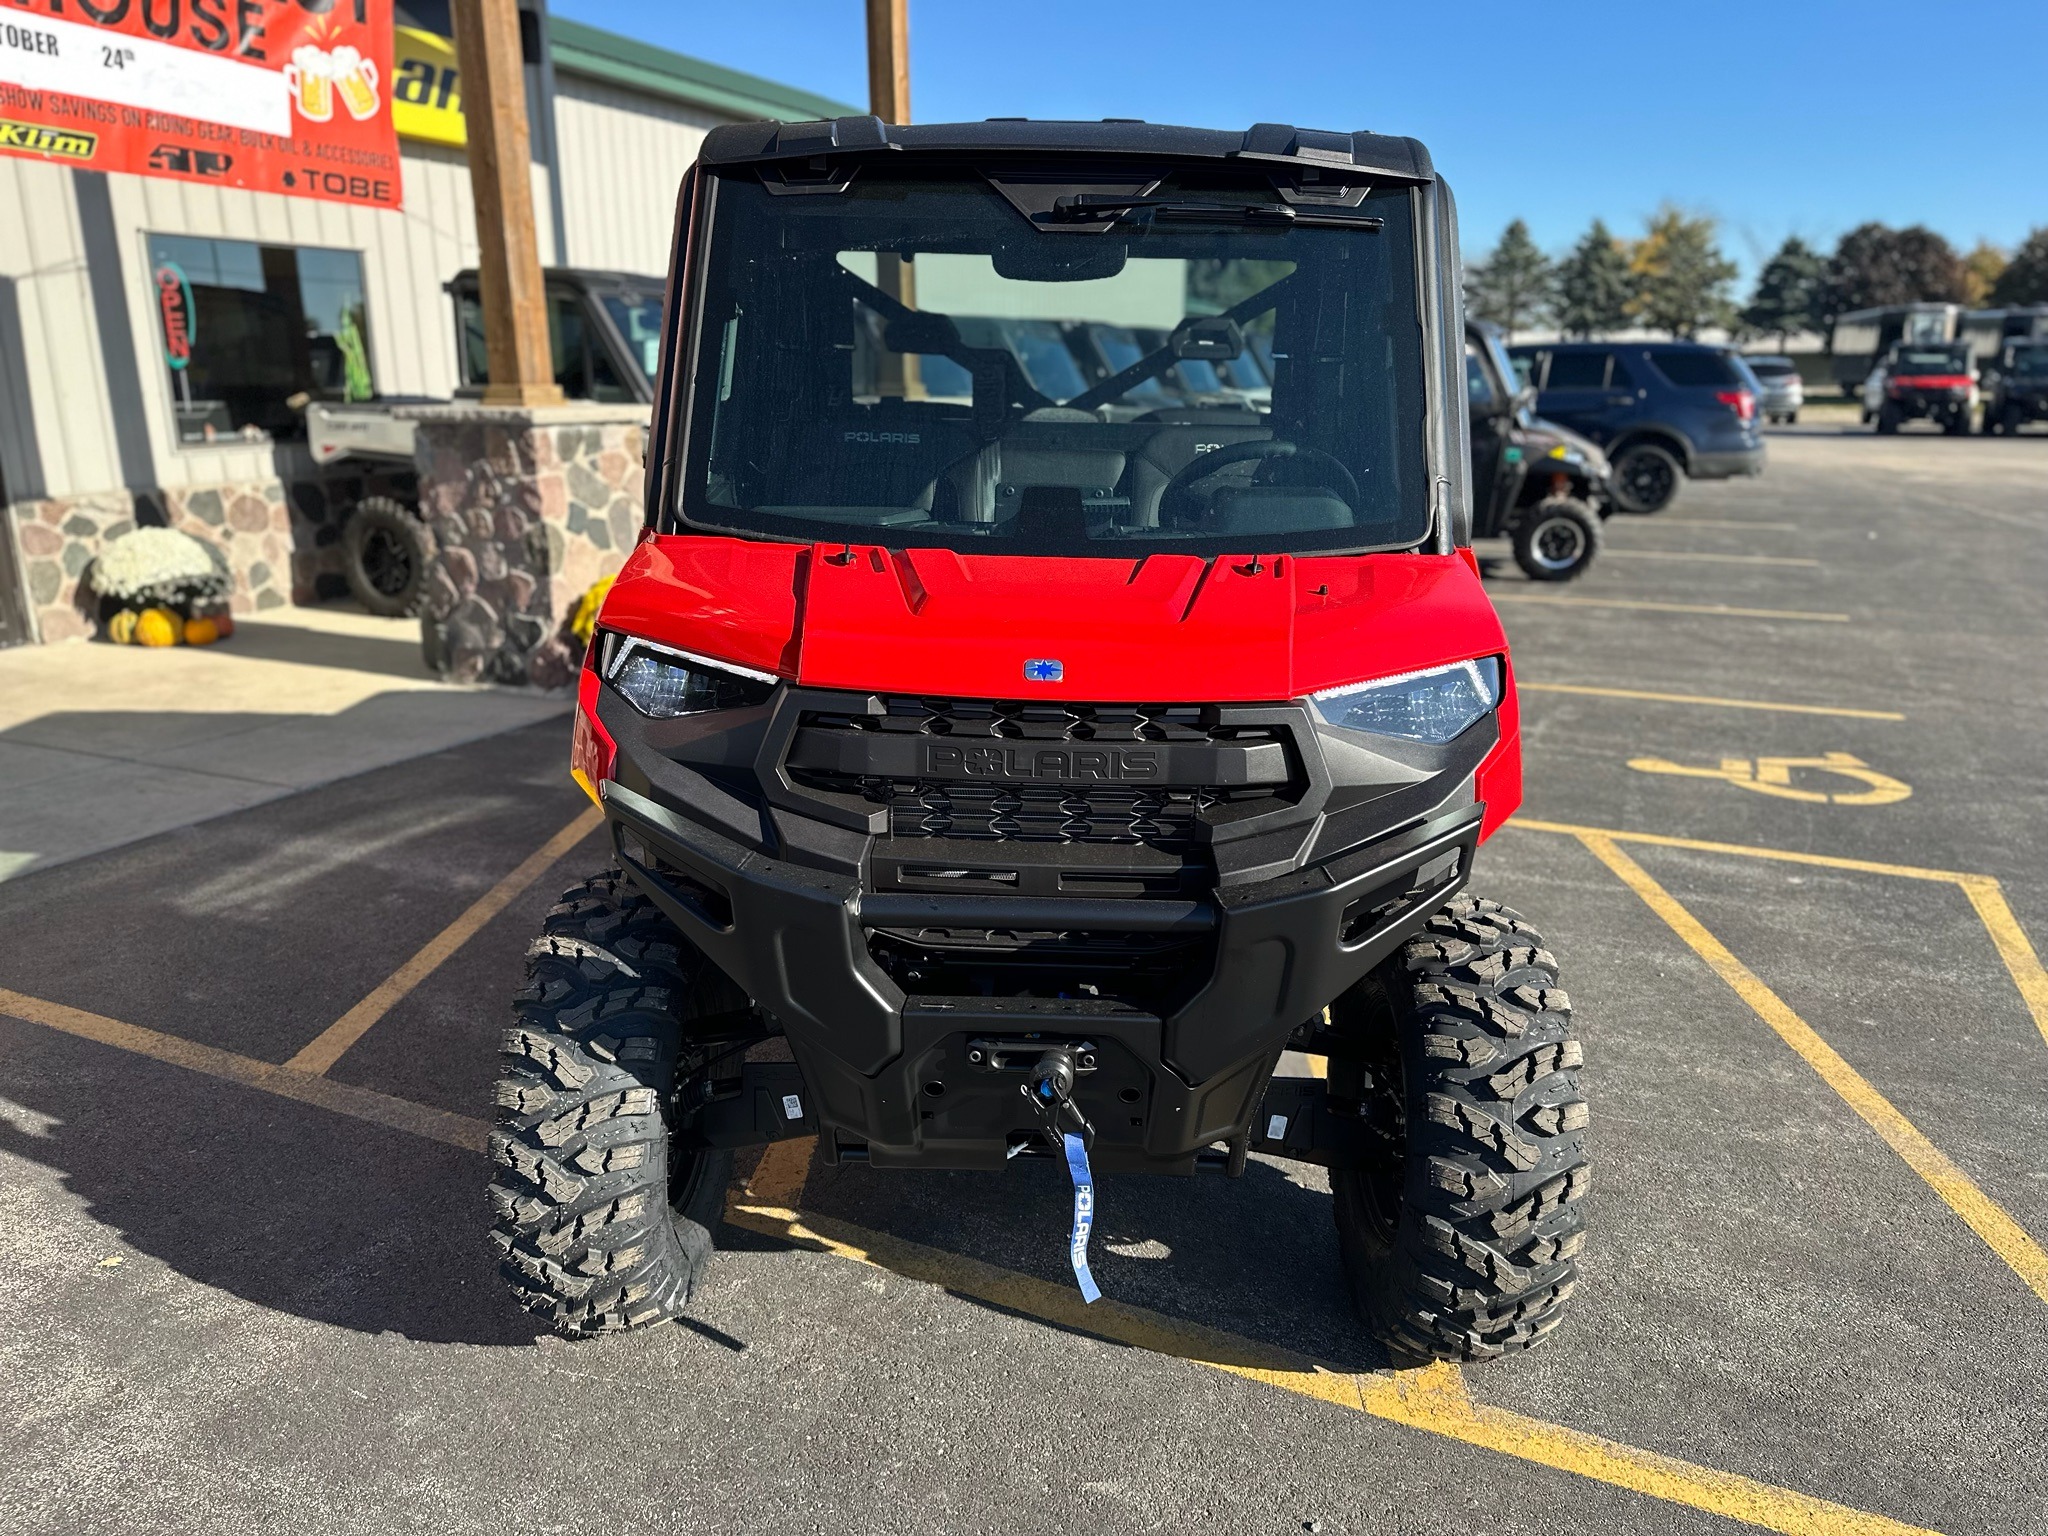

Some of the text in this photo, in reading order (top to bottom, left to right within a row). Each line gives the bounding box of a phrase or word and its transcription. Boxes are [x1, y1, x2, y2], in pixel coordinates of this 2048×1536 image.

[15, 0, 266, 61] USE
[50, 95, 117, 124] SAVINGS
[121, 108, 142, 128] ON
[146, 112, 193, 137] RIDING
[301, 168, 391, 202] TOBE
[157, 267, 190, 358] OPEN
[844, 431, 920, 444] POLARIS
[926, 745, 1158, 780] POLARIS
[1072, 1185, 1092, 1270] POLARIS
